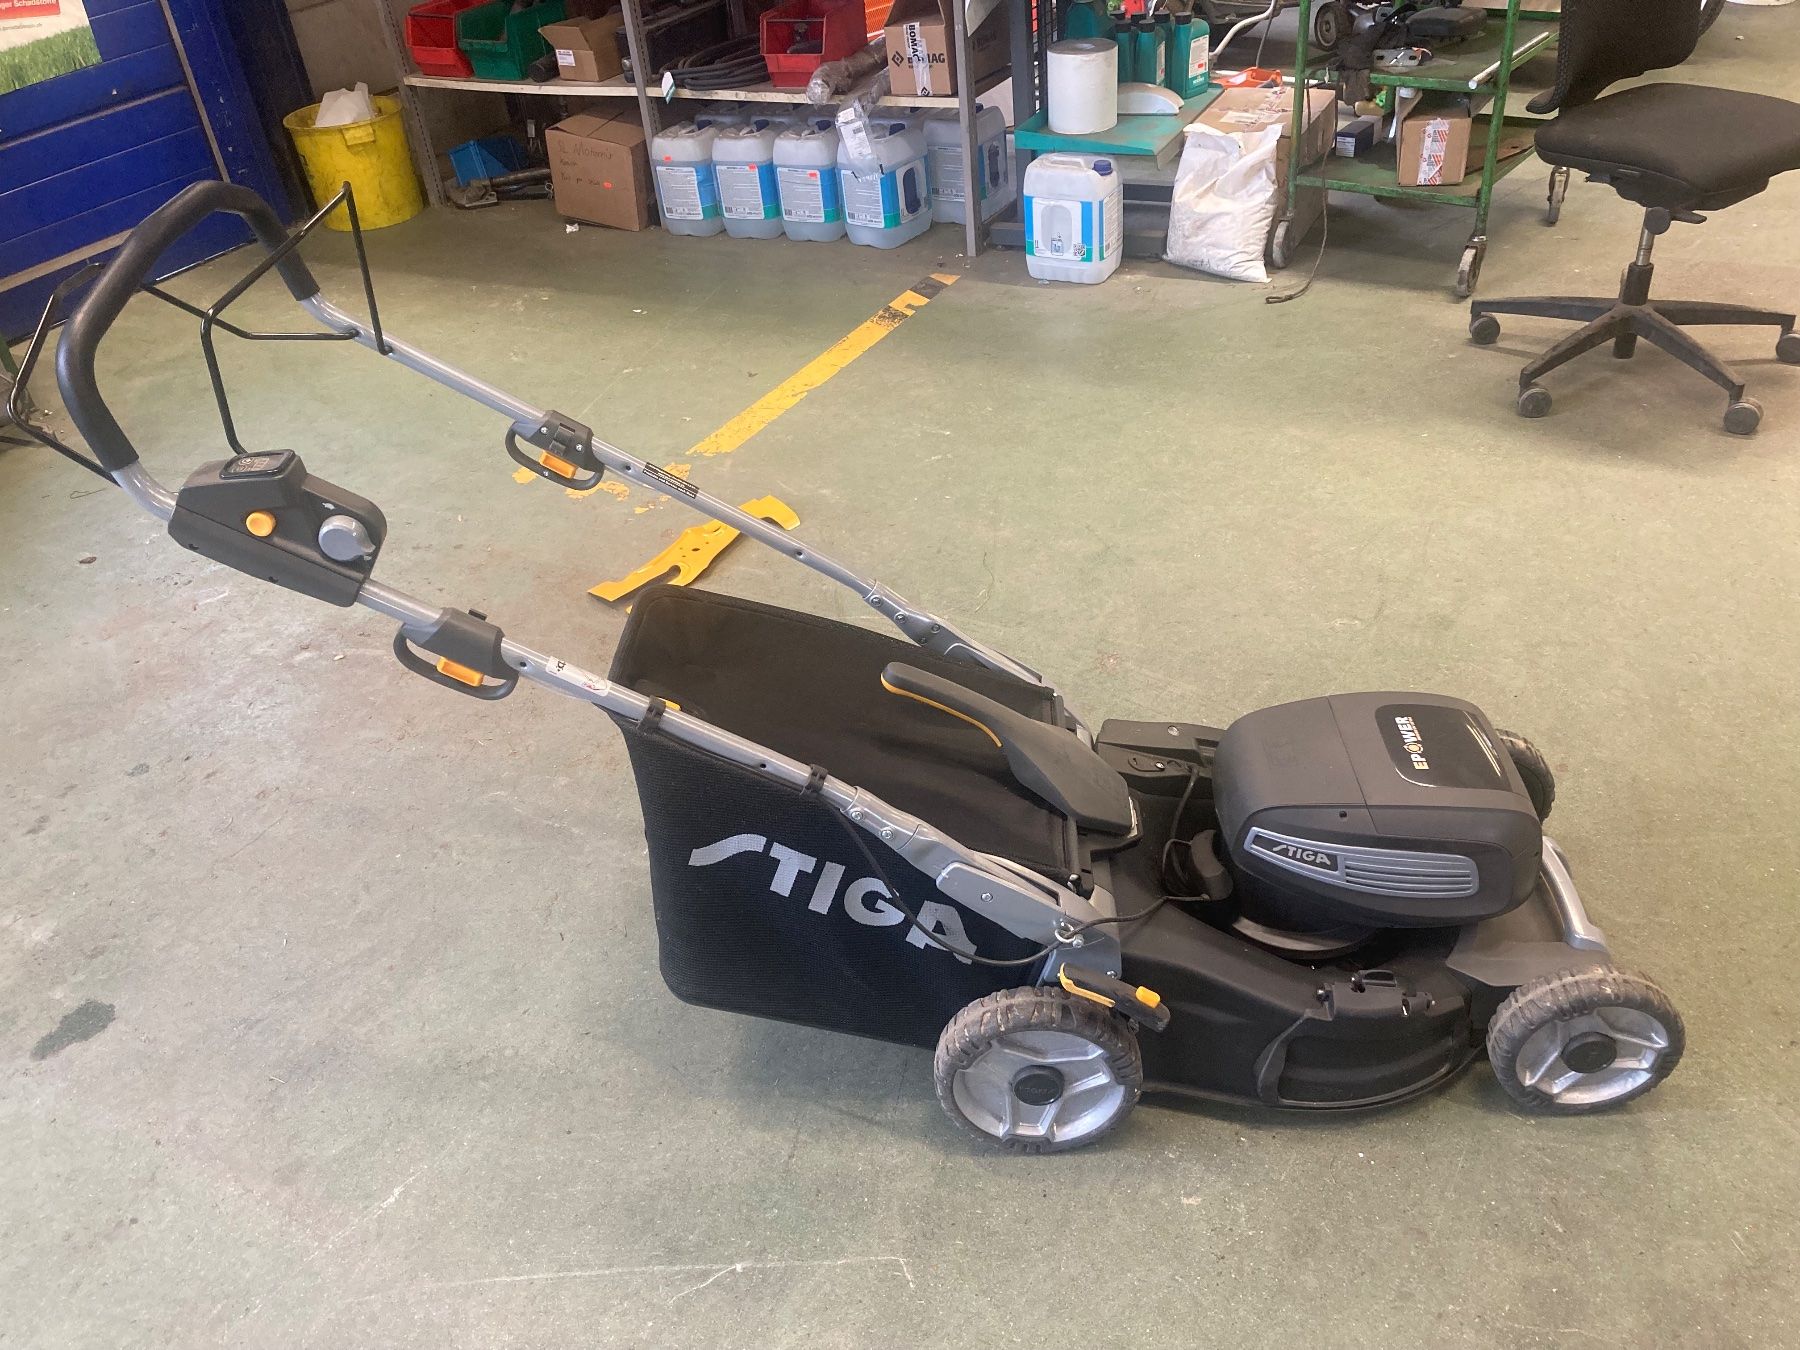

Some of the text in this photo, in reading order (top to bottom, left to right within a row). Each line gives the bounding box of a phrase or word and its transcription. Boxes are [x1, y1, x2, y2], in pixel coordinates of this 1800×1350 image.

[907, 53, 945, 64] BAG
[1394, 716, 1430, 770] EPOWER
[1272, 844, 1331, 866] STIGA
[688, 833, 978, 965] STIGA
